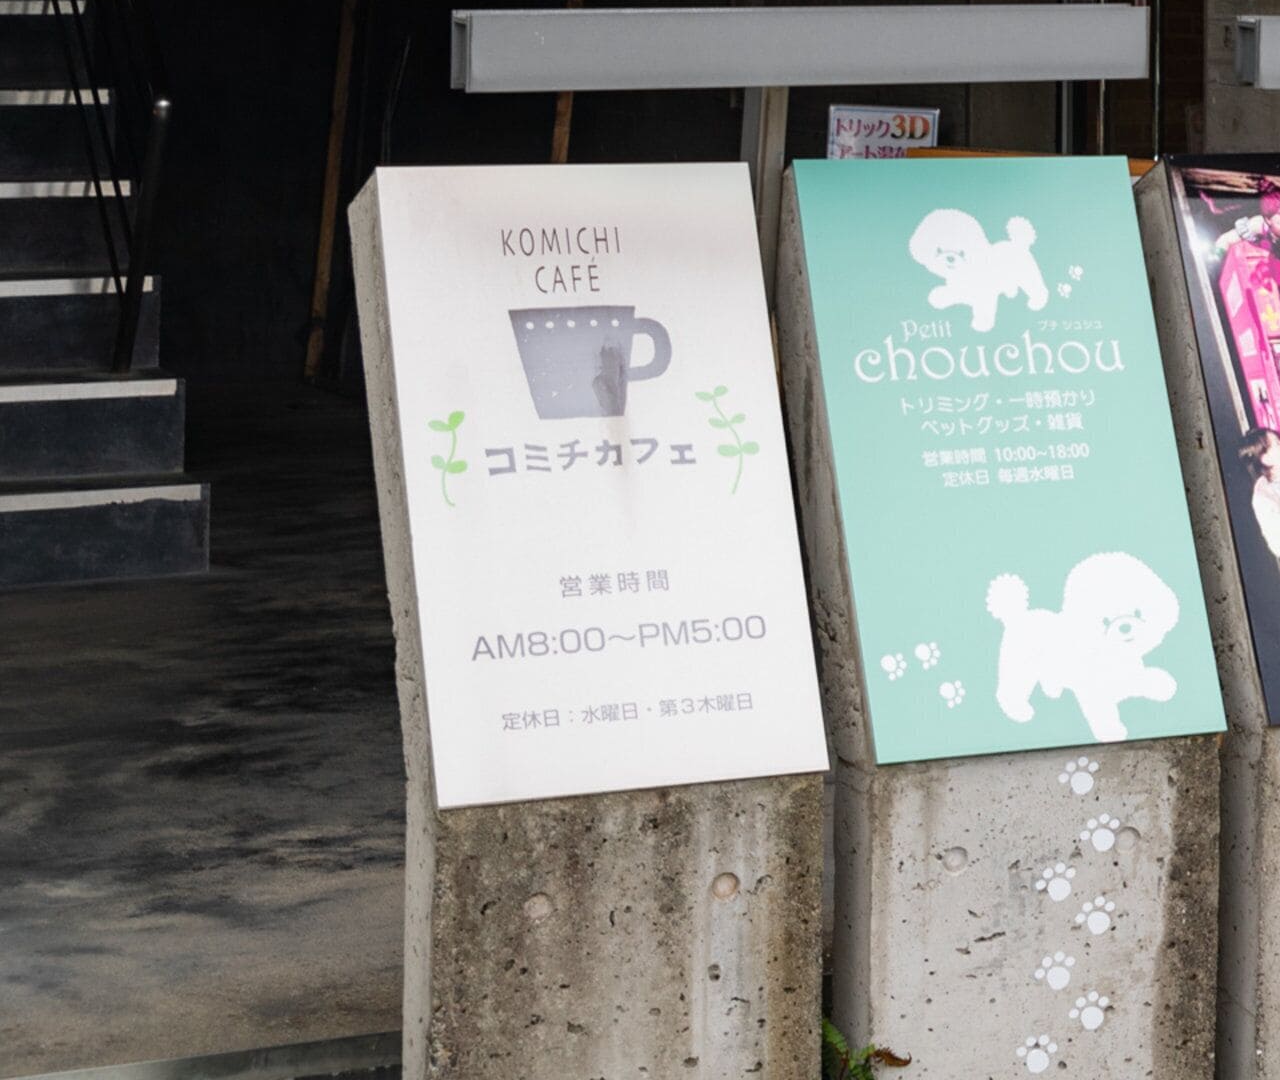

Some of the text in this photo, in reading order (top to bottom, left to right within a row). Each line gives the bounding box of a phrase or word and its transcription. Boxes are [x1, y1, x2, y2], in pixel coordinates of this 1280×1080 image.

[836, 113, 930, 139] トリック3D
[501, 227, 621, 257] KOMICHI
[535, 257, 601, 294] CAFÉ
[901, 320, 953, 342] Petit
[854, 329, 1127, 383] chouchou
[901, 389, 1096, 415] トリミング・一時預かり
[920, 412, 1084, 437] ペットグッズ・雑貨
[485, 437, 697, 476] コミチカフェ
[921, 446, 987, 468] 営業時間
[942, 464, 1075, 488] 定休日 毎週水曜日
[559, 569, 670, 599] 営業時間
